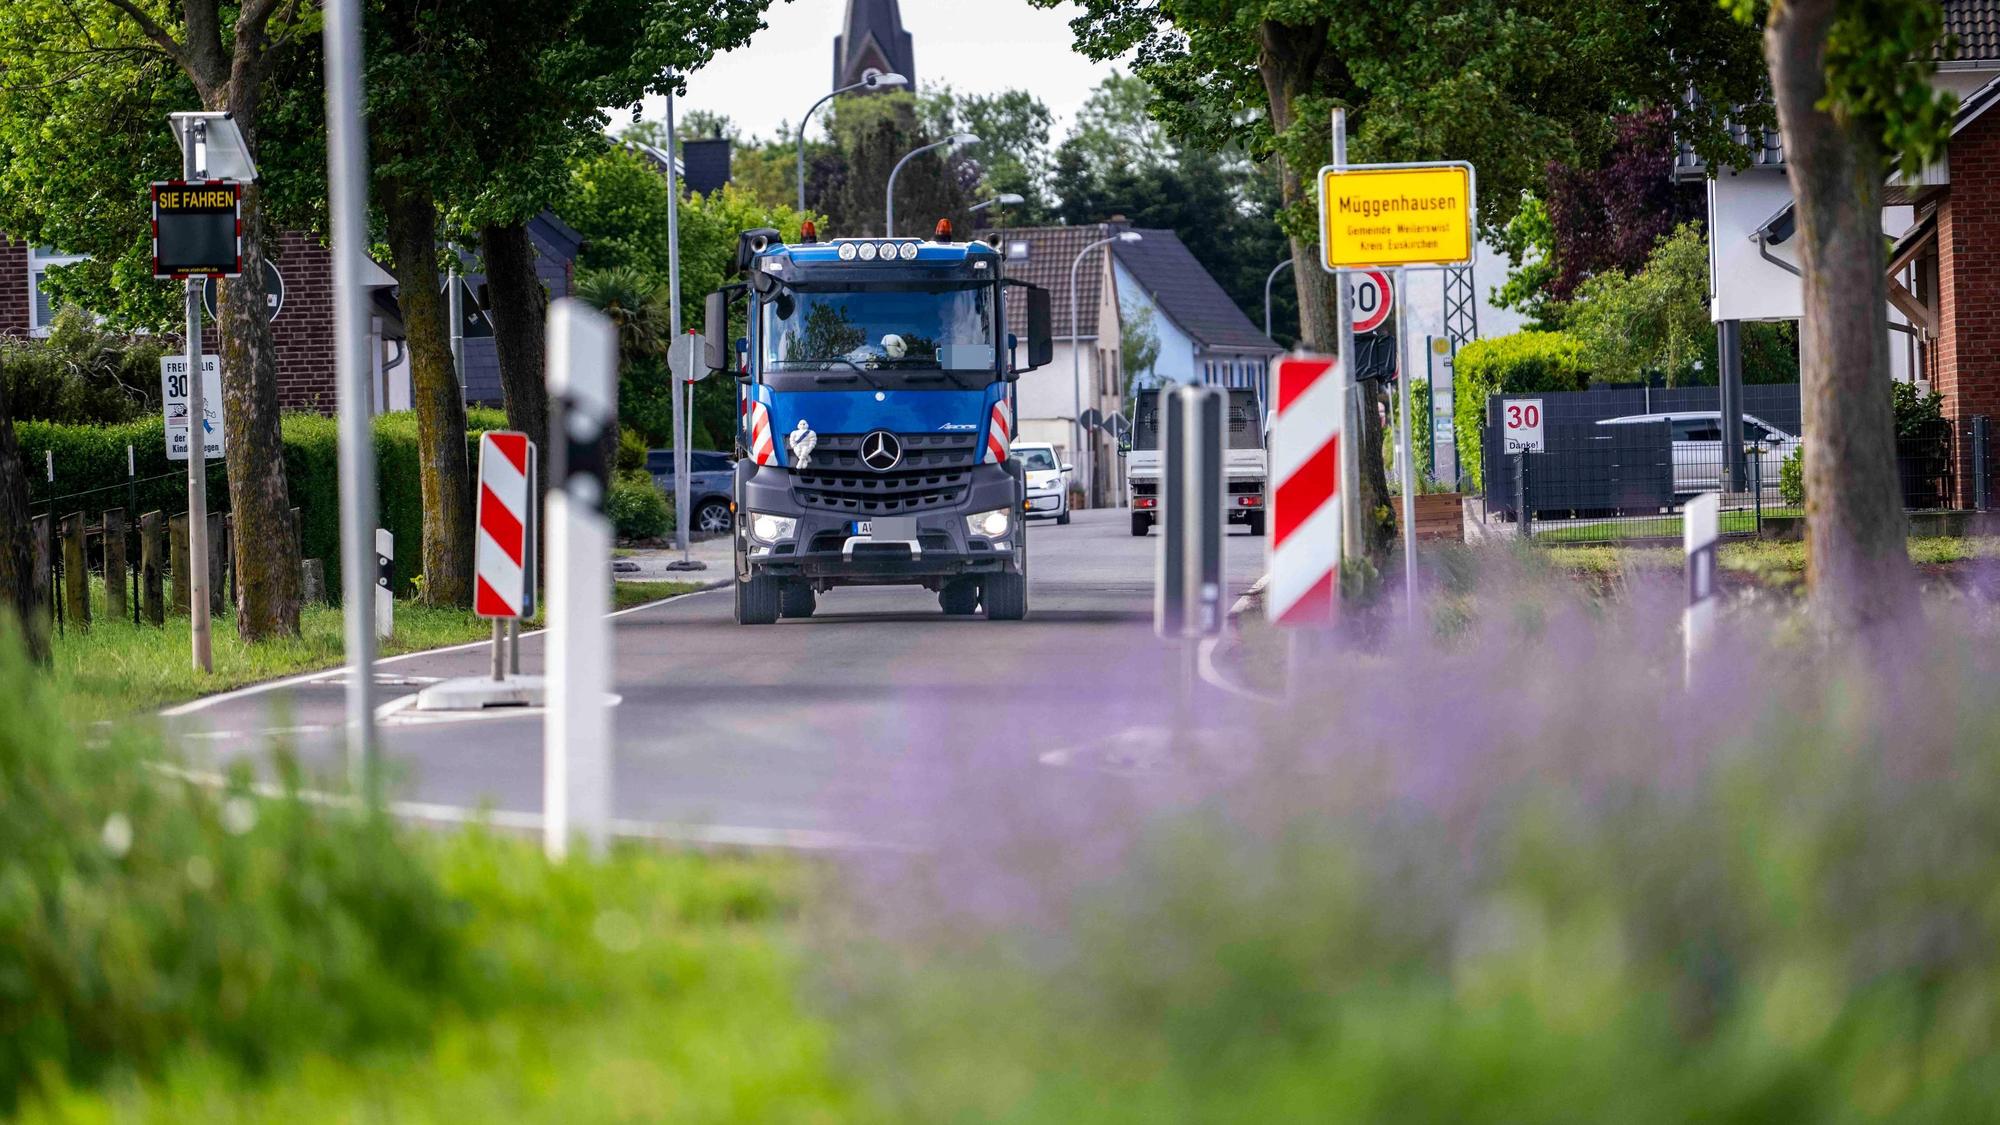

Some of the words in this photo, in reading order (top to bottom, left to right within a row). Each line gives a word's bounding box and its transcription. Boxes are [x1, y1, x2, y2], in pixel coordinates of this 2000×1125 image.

[160, 192, 179, 208] SIE
[183, 191, 234, 208] FAHREN
[1339, 195, 1456, 217] Müggenhausen
[1347, 225, 1391, 236] Gemeinde
[167, 361, 214, 372] FREILIG
[168, 375, 188, 397] 30
[1507, 405, 1539, 428] 30
[174, 434, 186, 443] der
[172, 444, 188, 453] Kind
[203, 444, 220, 453] egen
[1509, 441, 1539, 450] Danke!
